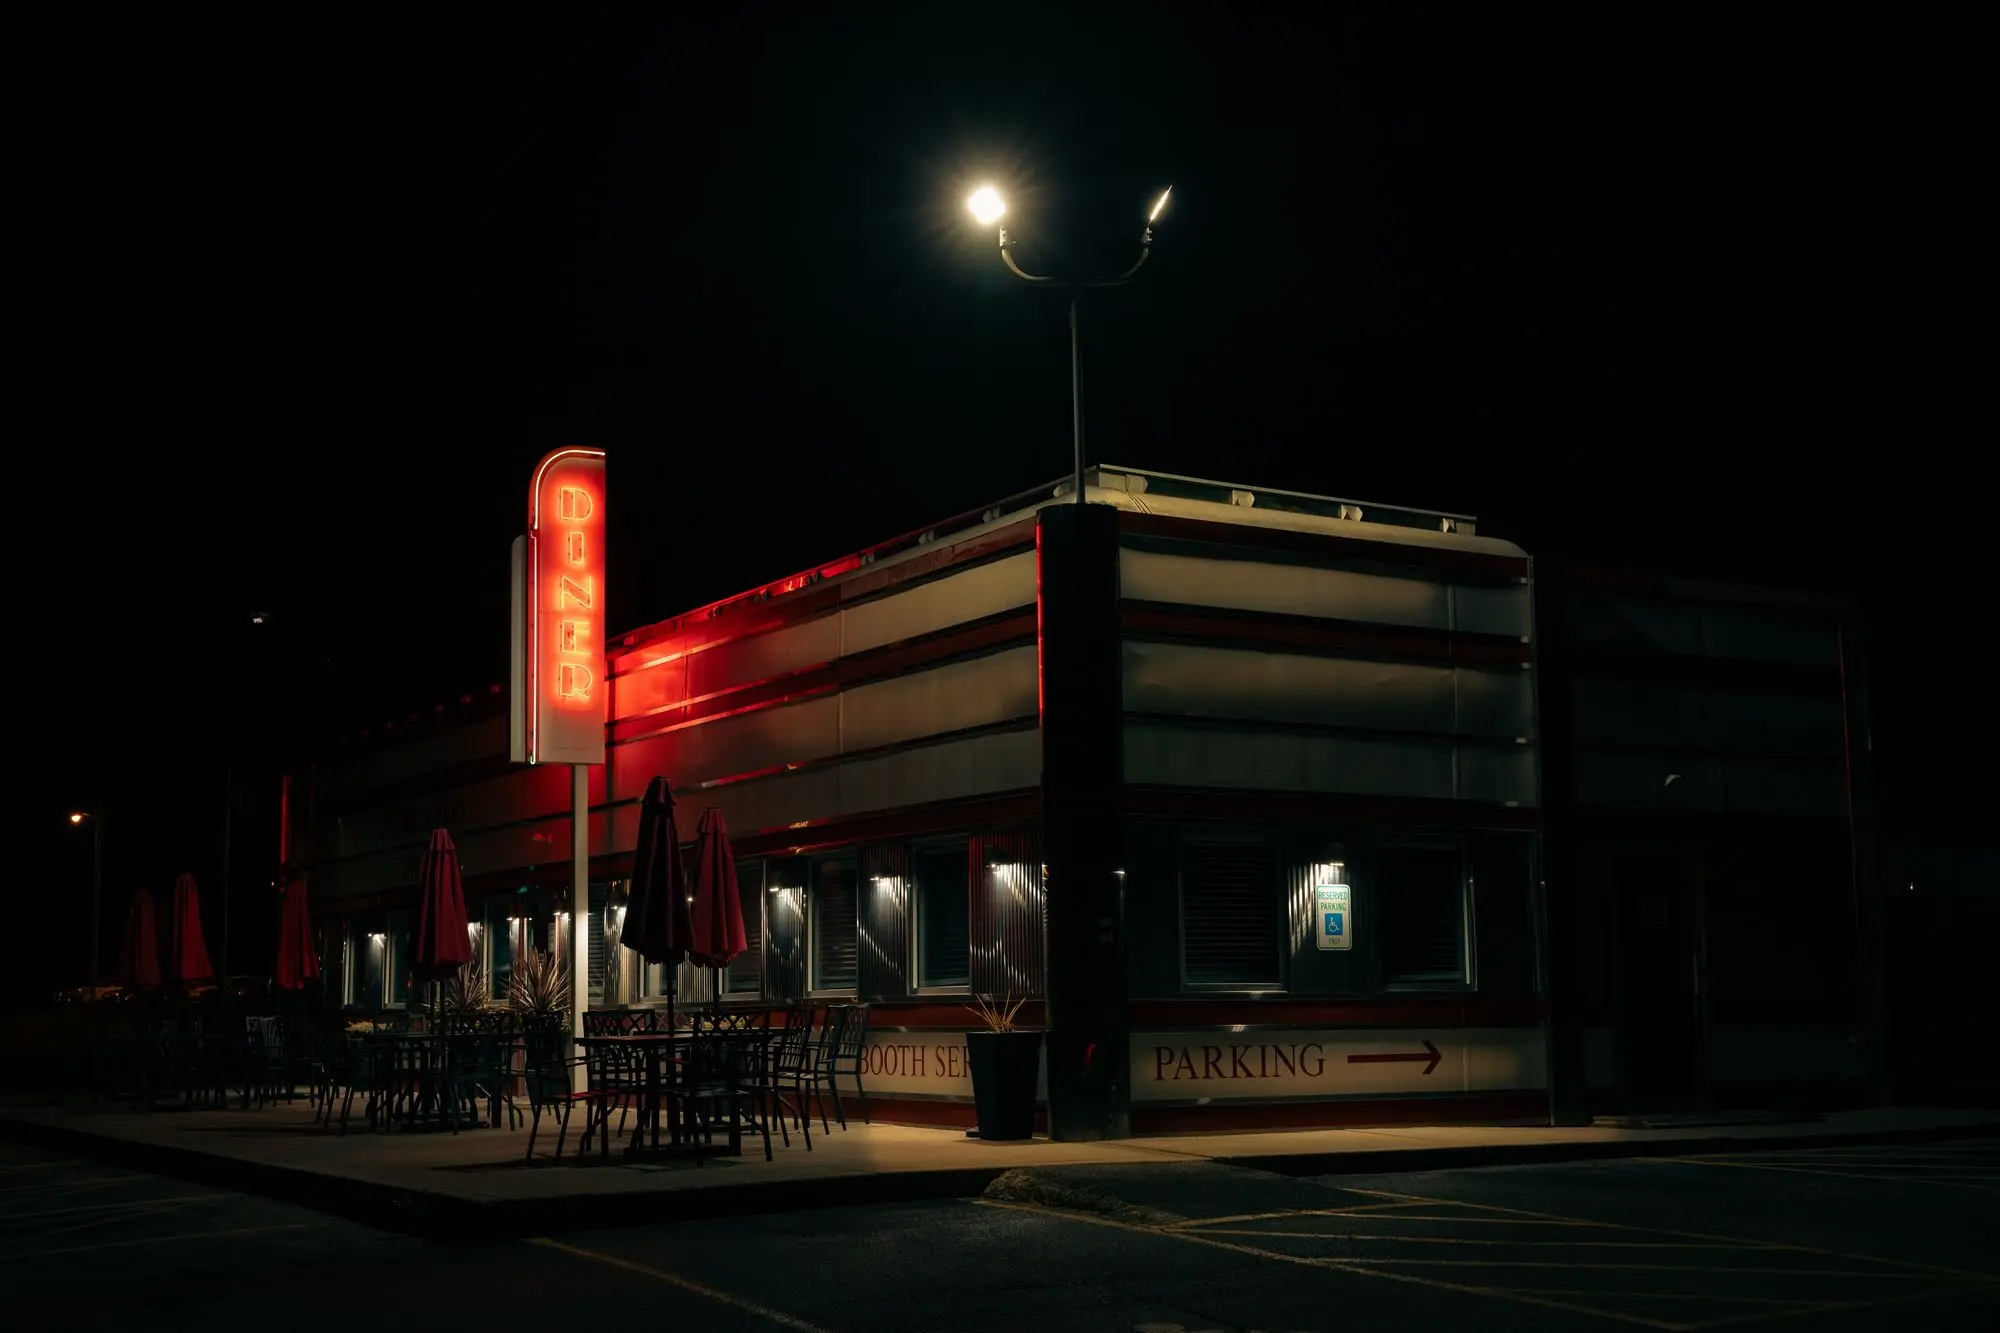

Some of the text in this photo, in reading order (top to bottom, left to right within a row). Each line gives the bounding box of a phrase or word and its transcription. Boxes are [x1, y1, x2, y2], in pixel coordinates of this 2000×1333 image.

[559, 487, 593, 699] DINER
[1318, 891, 1348, 900] RESERVED
[1320, 902, 1347, 911] PARKING
[859, 1044, 927, 1076] BOOTH
[1153, 1043, 1327, 1081] PARKING
